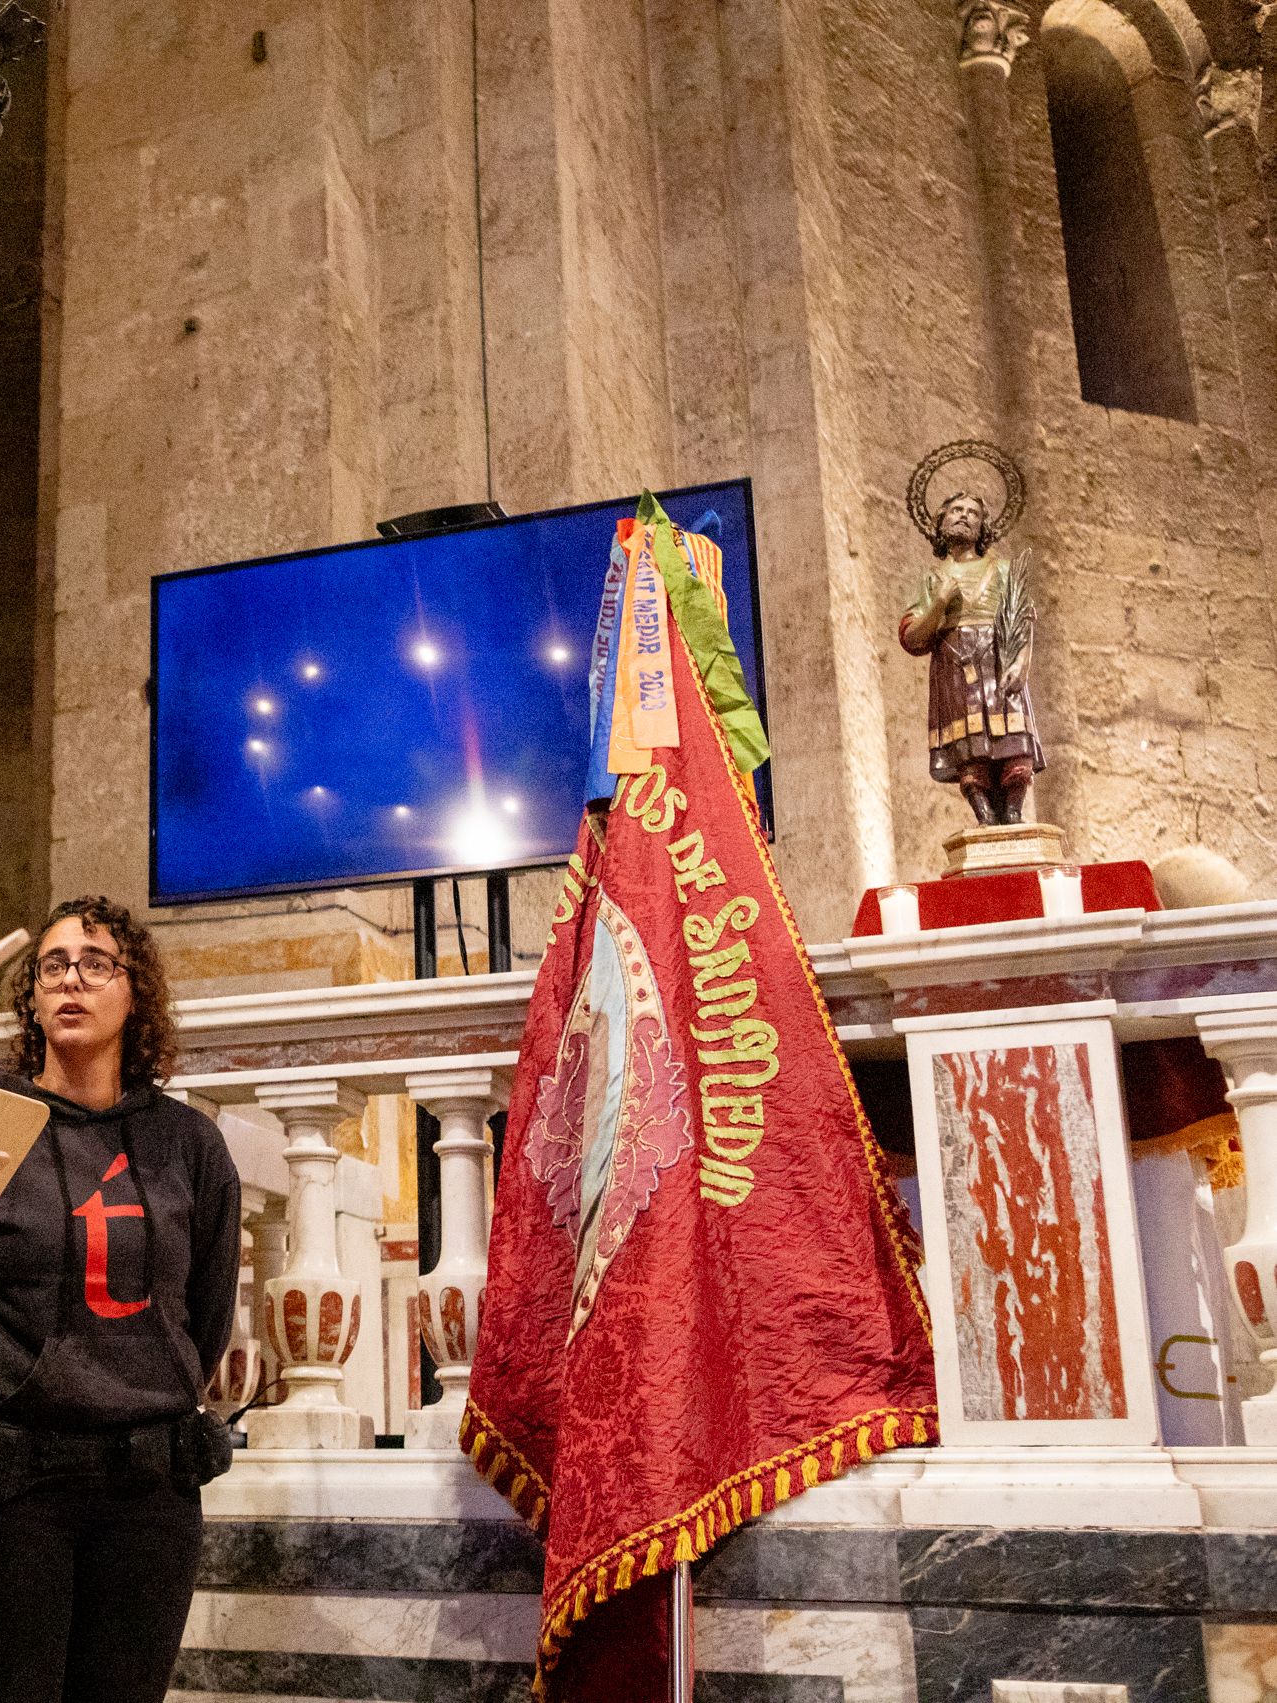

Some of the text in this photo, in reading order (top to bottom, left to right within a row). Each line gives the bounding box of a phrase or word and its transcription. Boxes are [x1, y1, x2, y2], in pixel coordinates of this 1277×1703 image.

[633, 599, 660, 655] MEDIR
[638, 670, 667, 711] 2023
[665, 829, 727, 903] DE
[683, 895, 760, 1020] SAN
